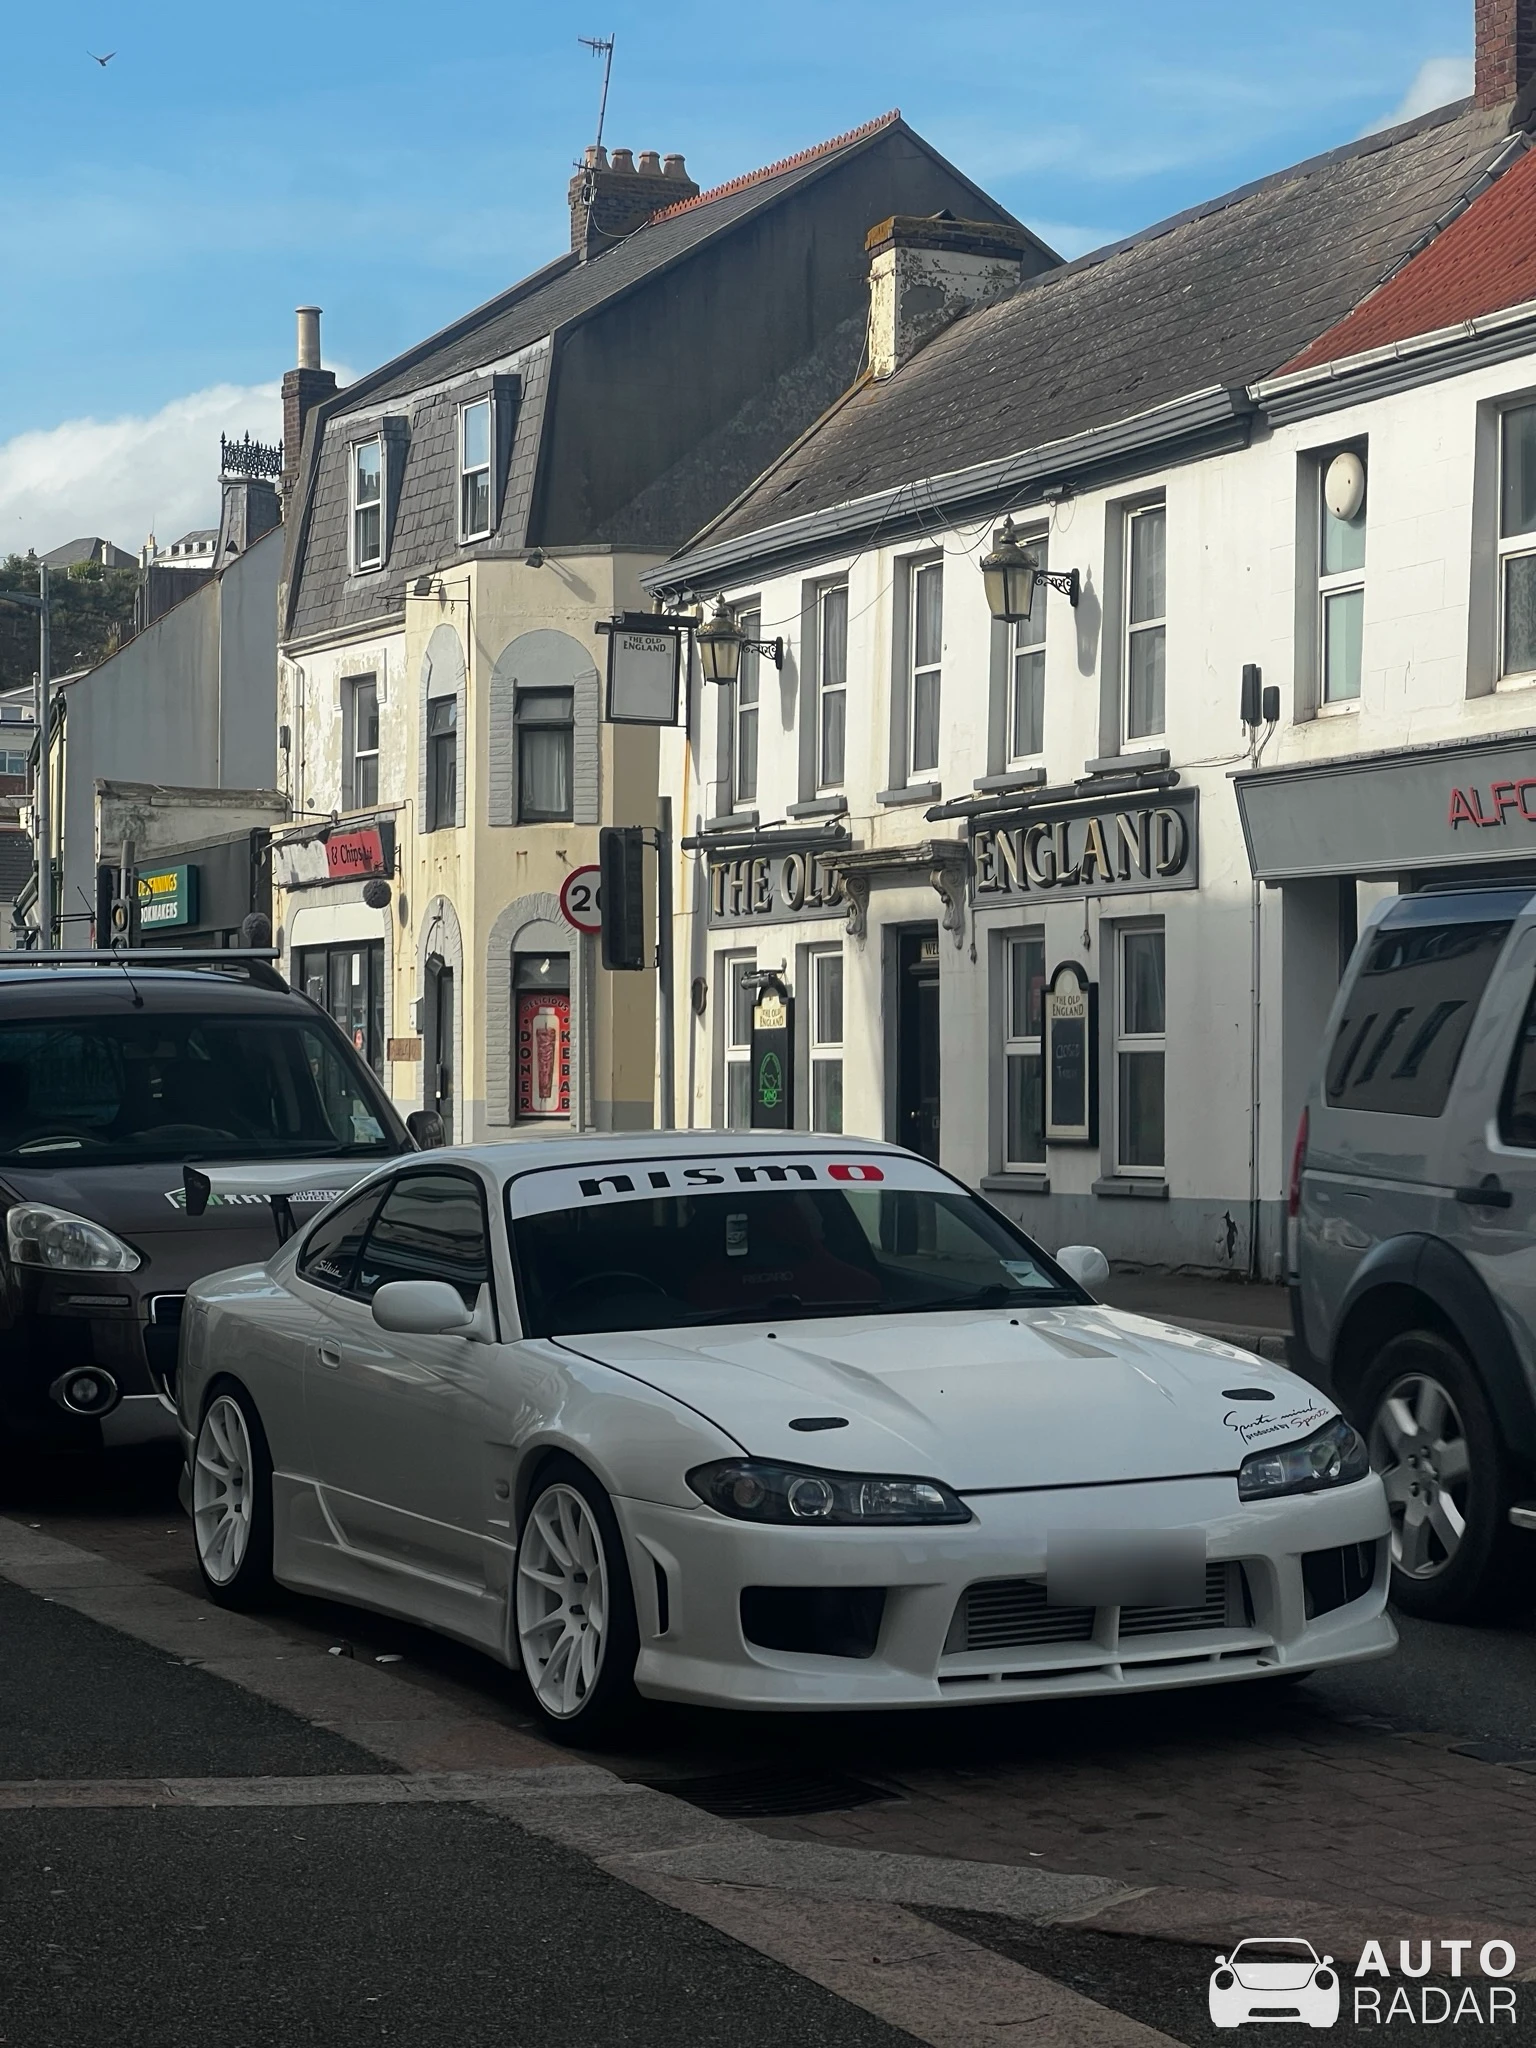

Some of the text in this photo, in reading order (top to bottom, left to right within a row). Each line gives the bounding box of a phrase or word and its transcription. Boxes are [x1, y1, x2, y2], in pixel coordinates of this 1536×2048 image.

[623, 641, 666, 652] ENGLAND
[629, 636, 662, 645] THE OLD
[331, 846, 338, 865] &
[340, 843, 362, 867] Chips
[974, 808, 1187, 893] ENGLAND
[571, 885, 601, 911] 2
[711, 857, 772, 916] THE
[523, 997, 568, 1012] DELICIOUS
[1052, 1004, 1084, 1016] ENGLAND
[1056, 994, 1080, 1006] THE OLD
[760, 1016, 784, 1027] ENGLAND
[520, 1030, 532, 1109] DONER
[560, 1030, 570, 1109] KEBAB
[578, 1164, 884, 1197] nismo
